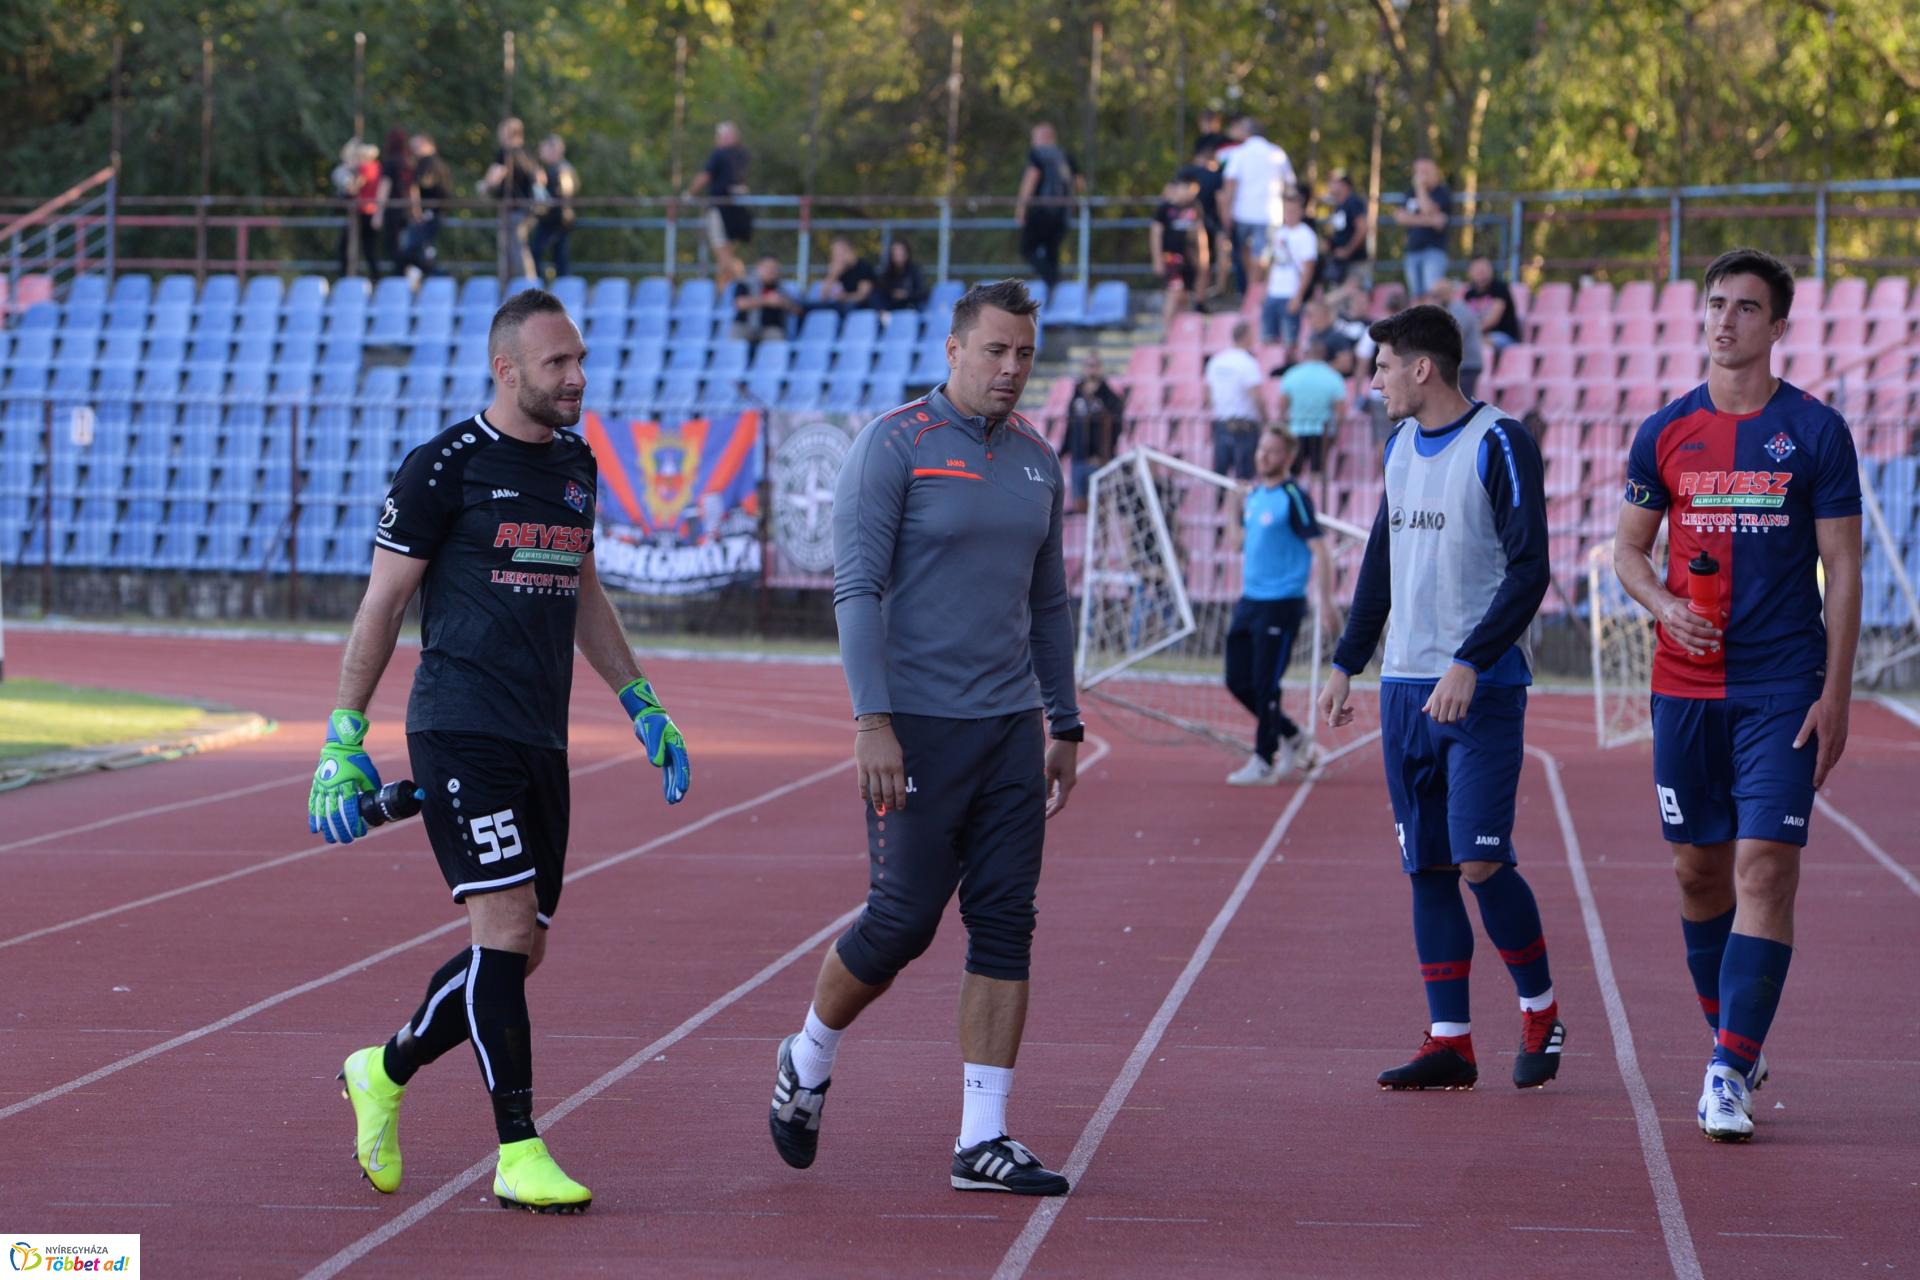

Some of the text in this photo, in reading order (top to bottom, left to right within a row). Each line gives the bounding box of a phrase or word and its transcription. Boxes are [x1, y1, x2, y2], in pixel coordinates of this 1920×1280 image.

[1678, 471, 1793, 496] REVESZ
[1694, 497, 1721, 505] ALWAYS
[1733, 496, 1745, 504] THE
[1745, 497, 1764, 505] RIGHT
[1409, 510, 1446, 531] JAKO
[1738, 513, 1790, 527] TRANS
[493, 522, 593, 553] REVESZ
[516, 551, 541, 559] ALWAYS
[554, 575, 580, 588] TRAN
[1656, 784, 1684, 825] 19
[1783, 815, 1805, 827] JAKO
[469, 808, 523, 865] 55
[1475, 835, 1500, 846] JAKO
